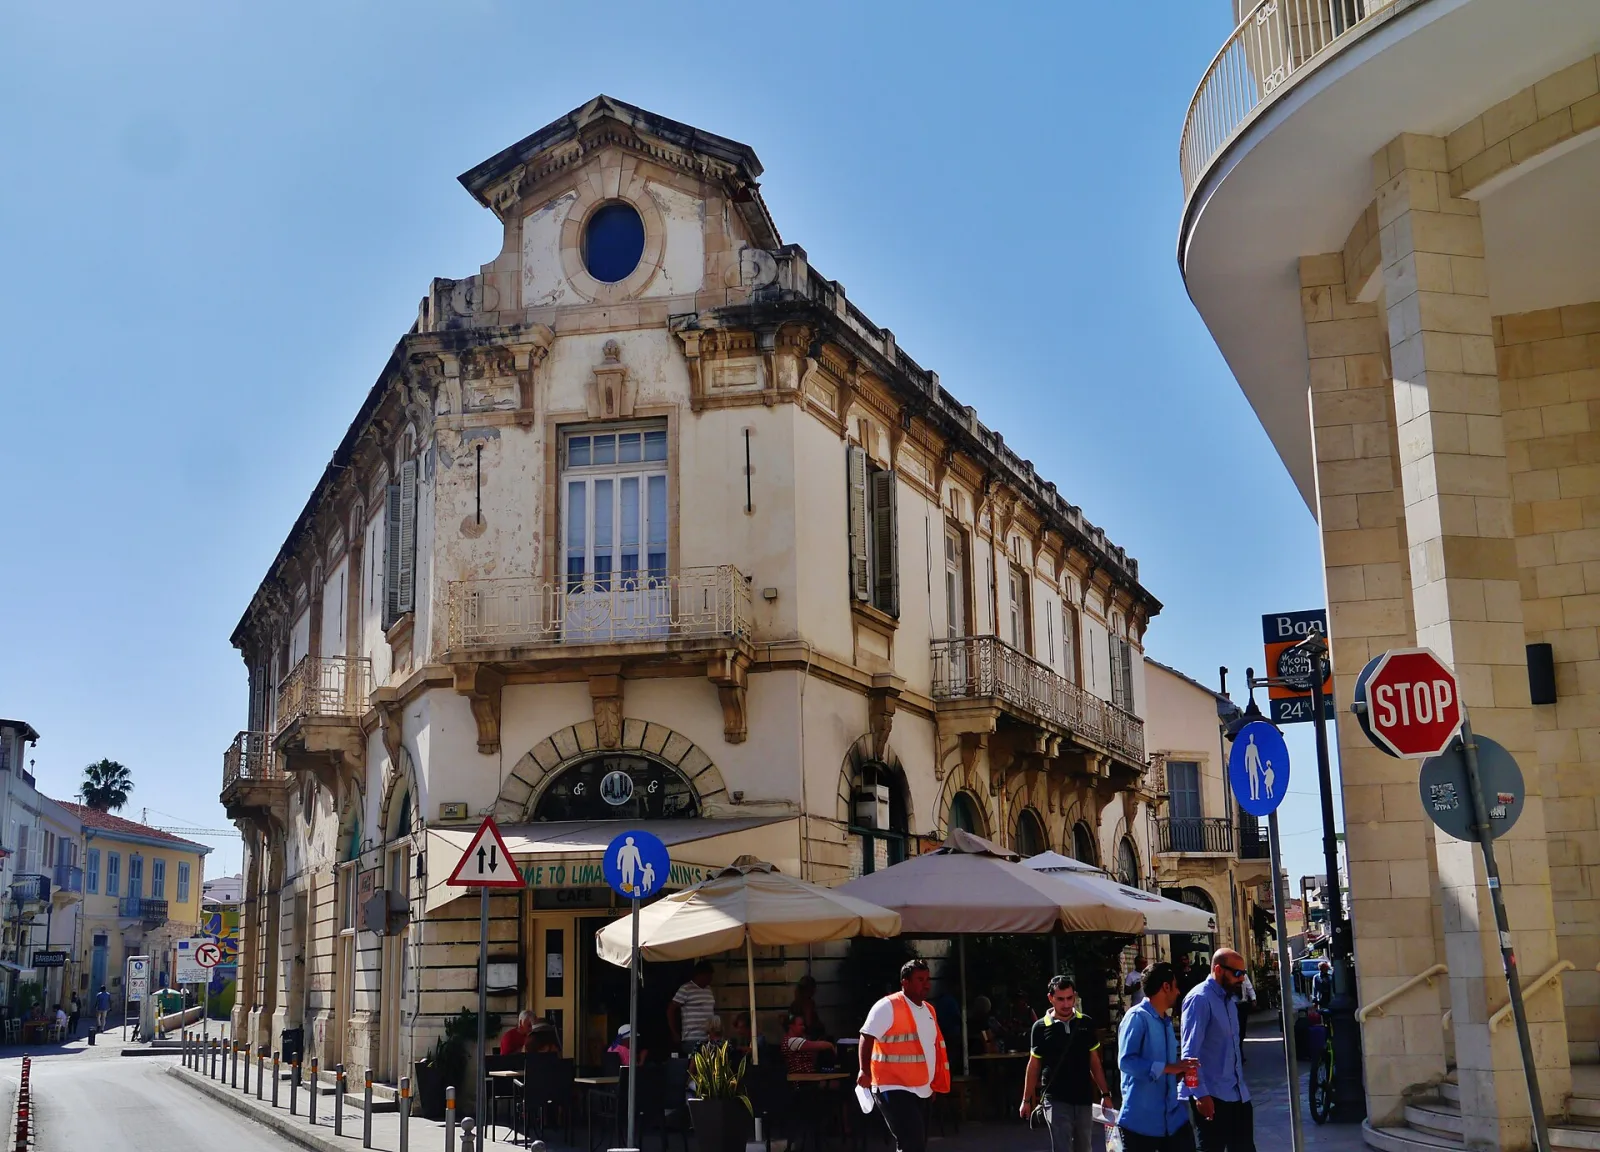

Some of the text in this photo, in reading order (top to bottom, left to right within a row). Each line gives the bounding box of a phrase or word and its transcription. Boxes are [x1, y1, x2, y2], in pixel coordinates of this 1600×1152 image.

[1276, 615, 1325, 636] Ban
[1279, 701, 1304, 720] 24
[1376, 679, 1453, 728] STOP
[549, 866, 567, 884] TO
[572, 865, 607, 884] LIMA
[667, 864, 702, 885] WIN'S
